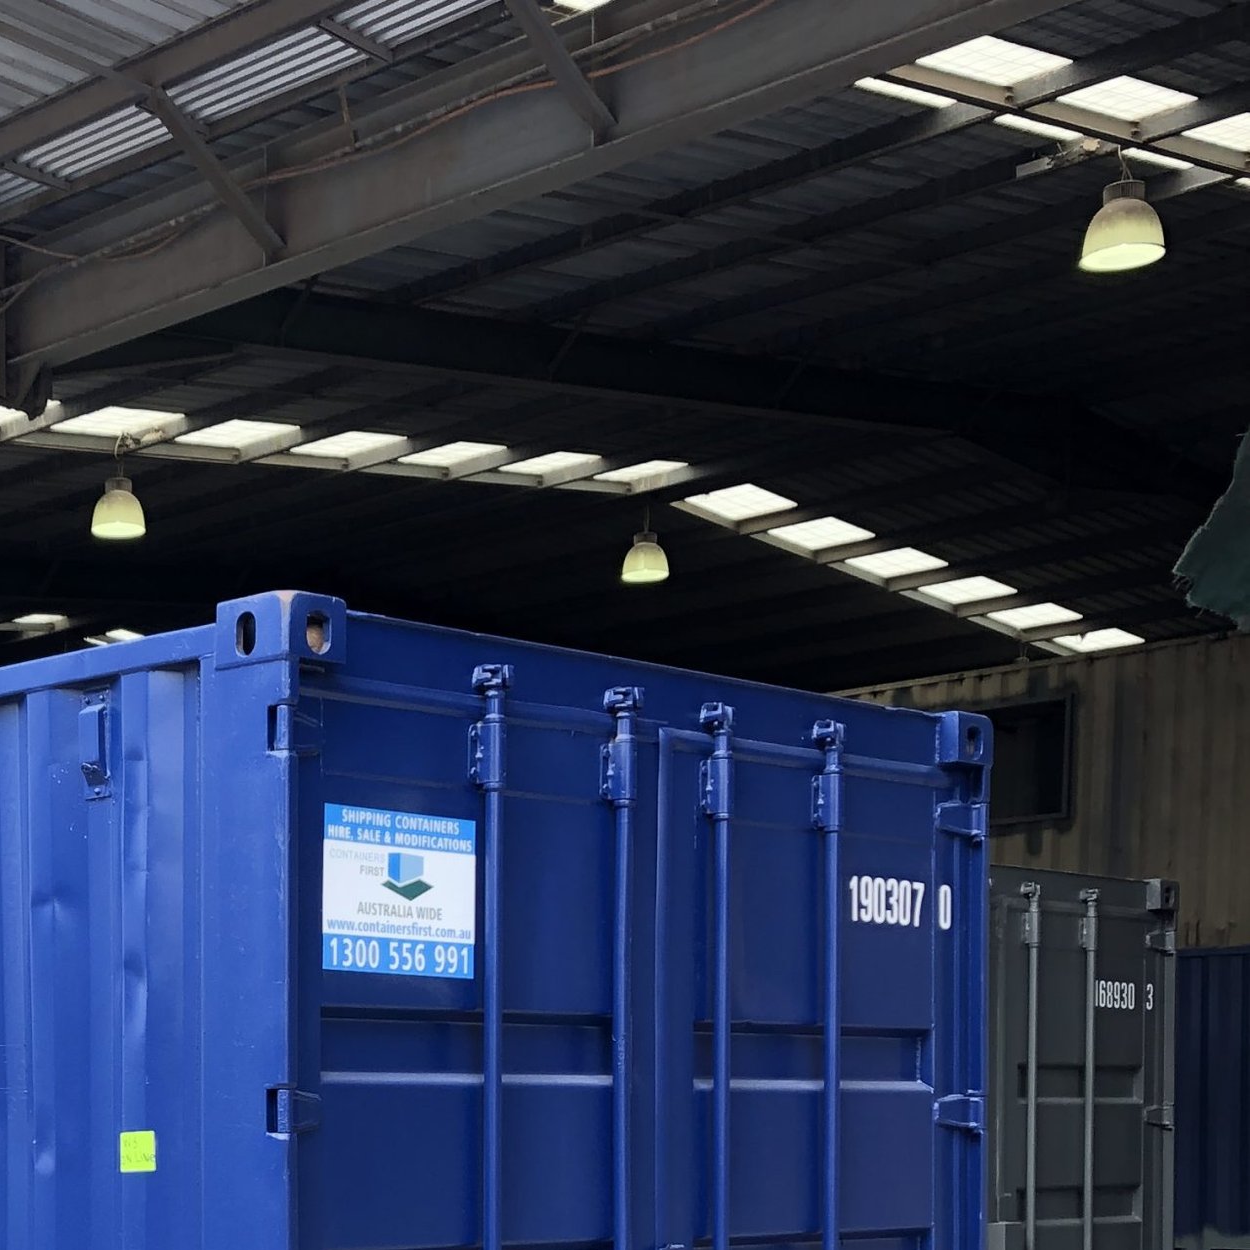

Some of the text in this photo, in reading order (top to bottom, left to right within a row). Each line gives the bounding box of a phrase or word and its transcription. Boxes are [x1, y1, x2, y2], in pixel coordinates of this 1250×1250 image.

[342, 808, 460, 835] SHIPPING CONTAINERS
[328, 824, 472, 852] HIRE, SALE & MODIFICATIONS
[329, 848, 386, 863] CONTAINERS
[359, 865, 385, 877] FIRST
[357, 901, 443, 921] AUSTRALIA WIDE
[849, 875, 952, 930] 190307 0
[327, 918, 471, 940] www.containersfirst.com.au
[330, 937, 469, 975] 1300 556 991
[1095, 979, 1154, 1011] 168930 3
